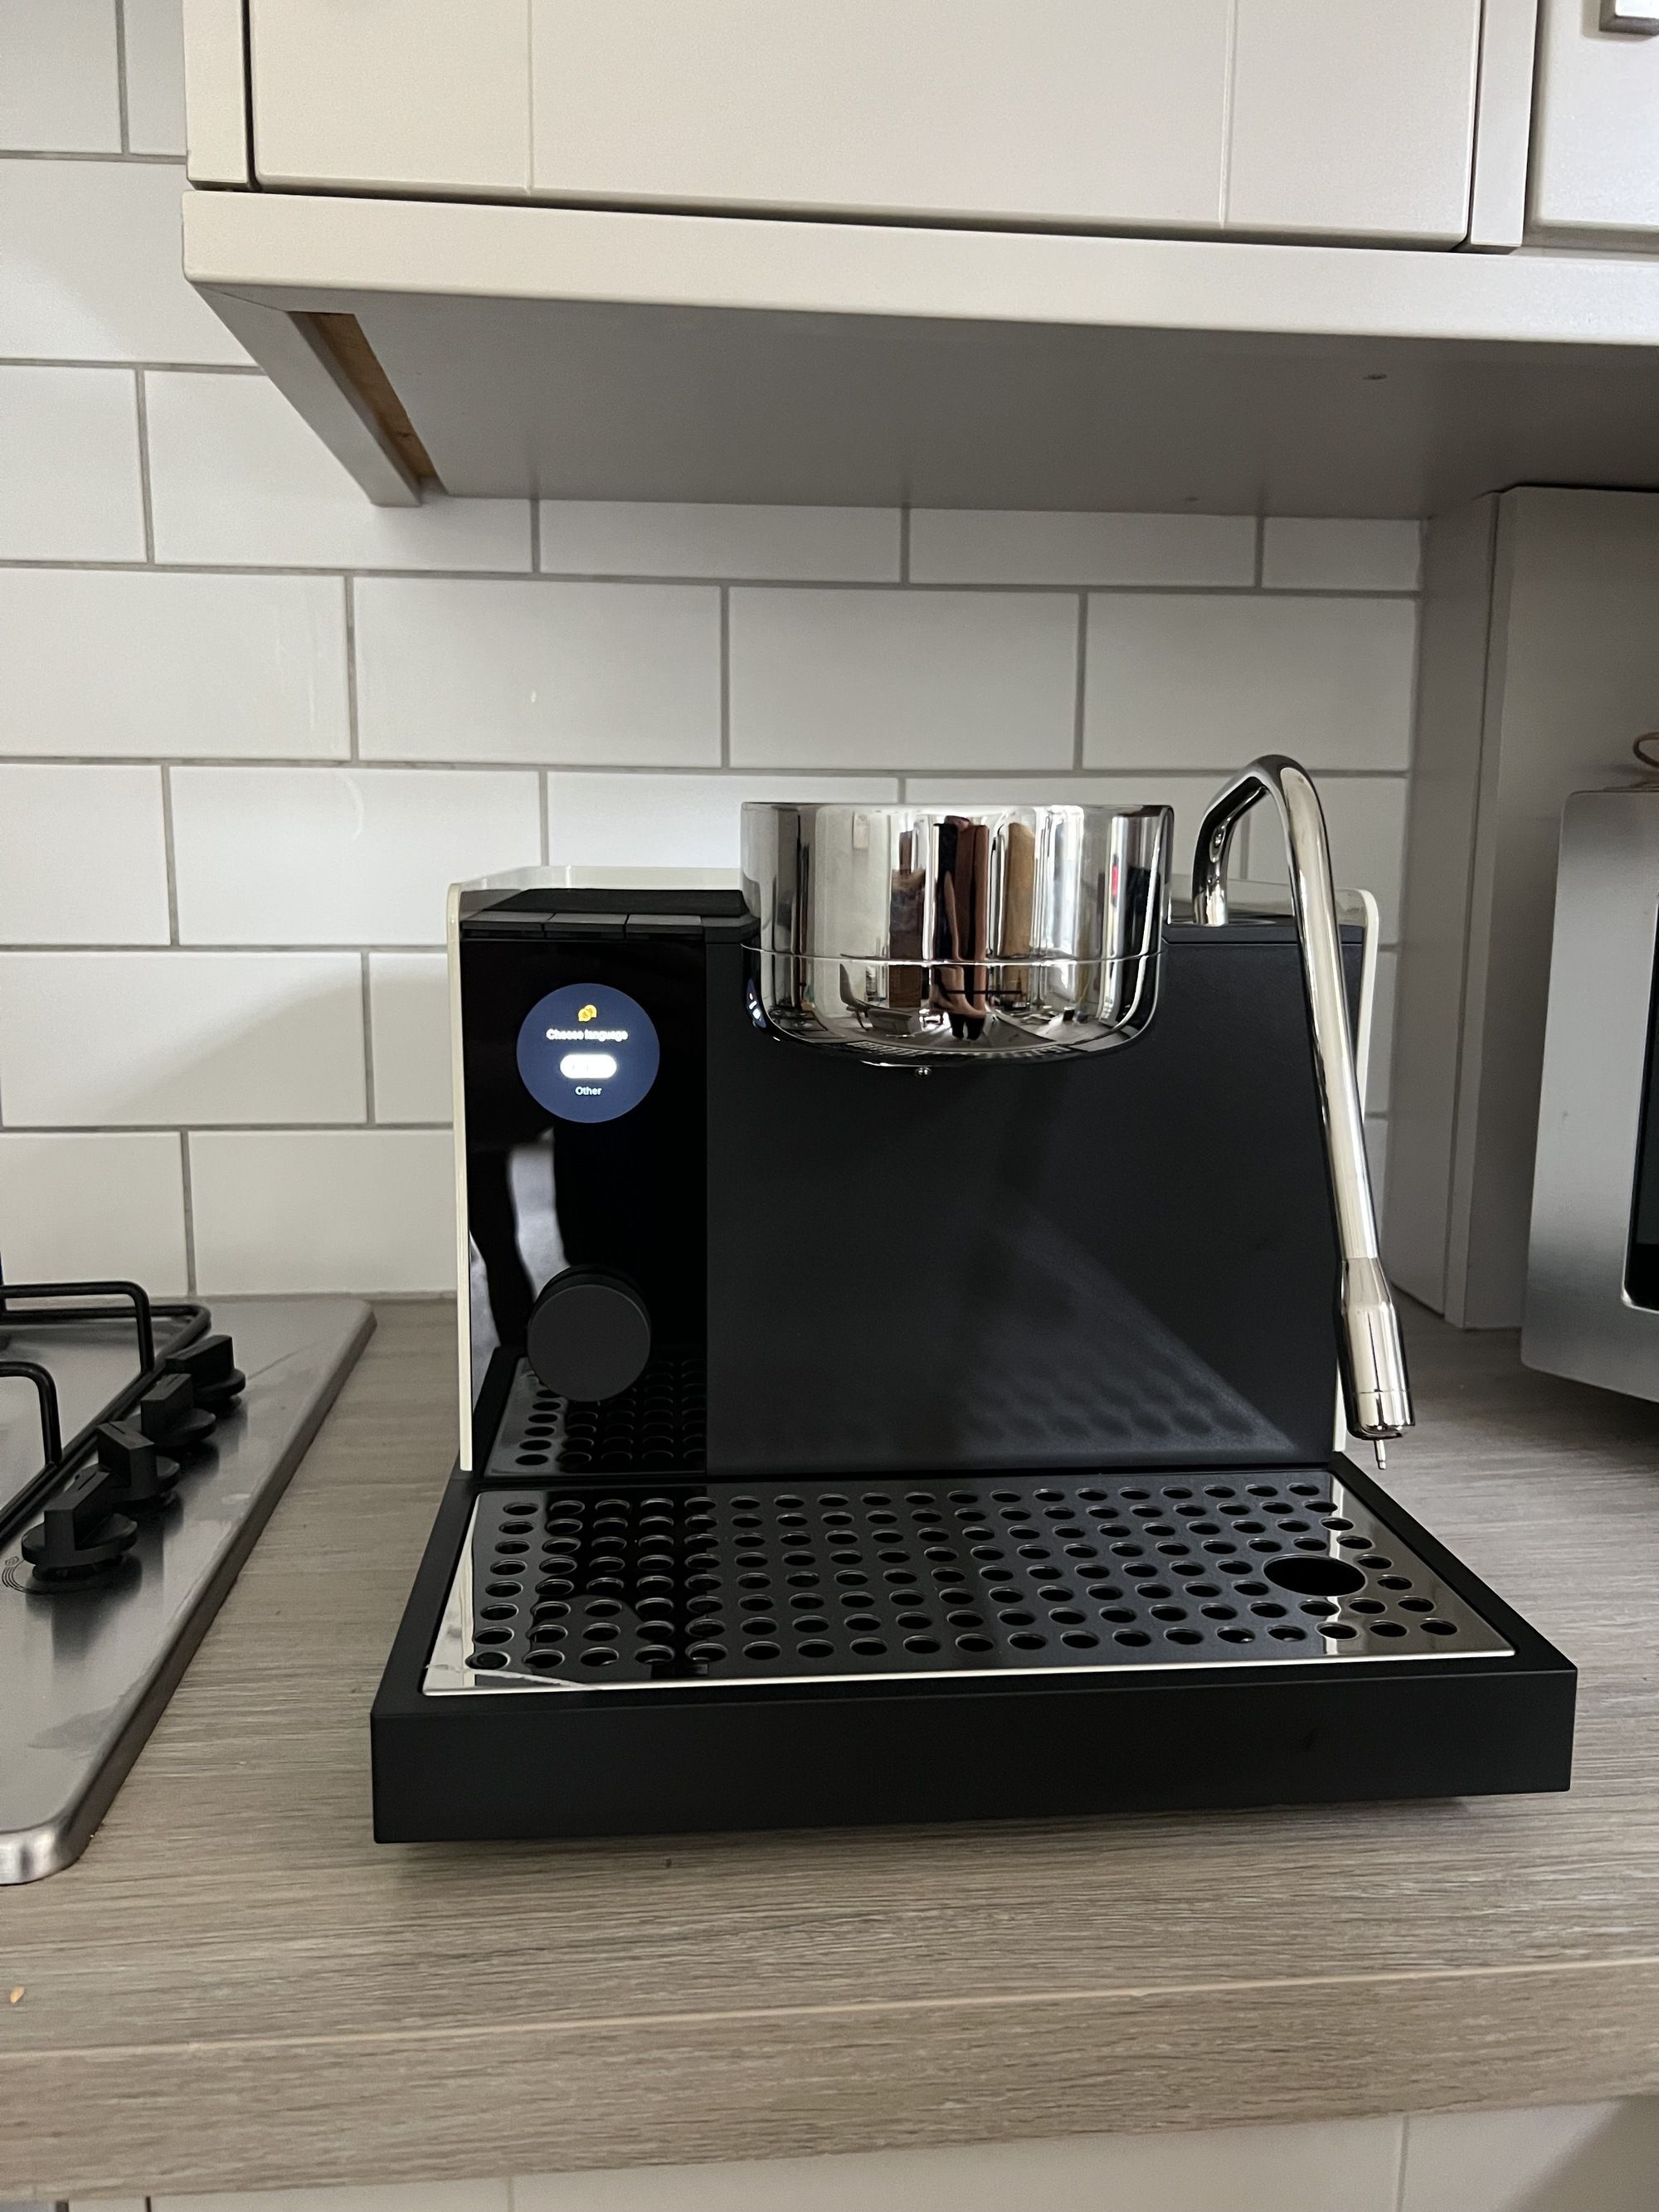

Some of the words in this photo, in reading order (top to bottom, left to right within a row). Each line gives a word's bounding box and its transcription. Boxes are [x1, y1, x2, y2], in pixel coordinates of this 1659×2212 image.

[546, 1028, 584, 1040] Choose
[584, 1029, 628, 1042] language
[575, 1087, 602, 1096] Other
